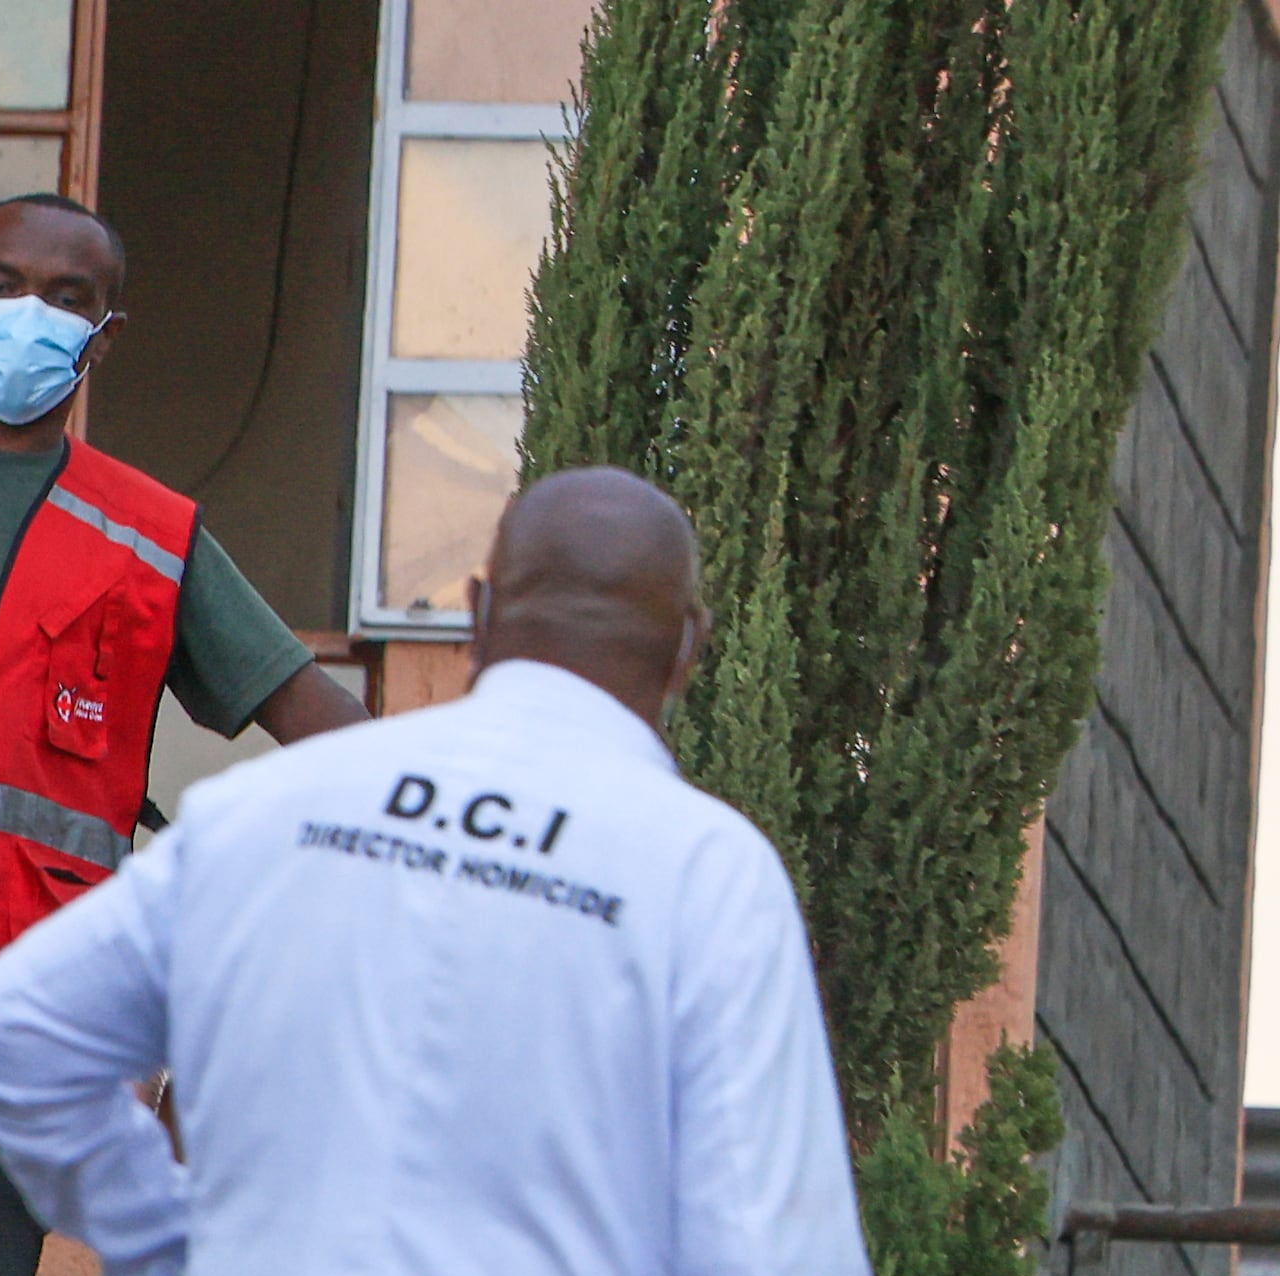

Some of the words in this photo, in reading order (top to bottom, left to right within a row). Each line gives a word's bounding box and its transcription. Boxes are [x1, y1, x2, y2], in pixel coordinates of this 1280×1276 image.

[384, 773, 571, 855] D.C.I
[297, 821, 448, 875] DIRECTOR
[455, 856, 625, 927] HOMICIDE
